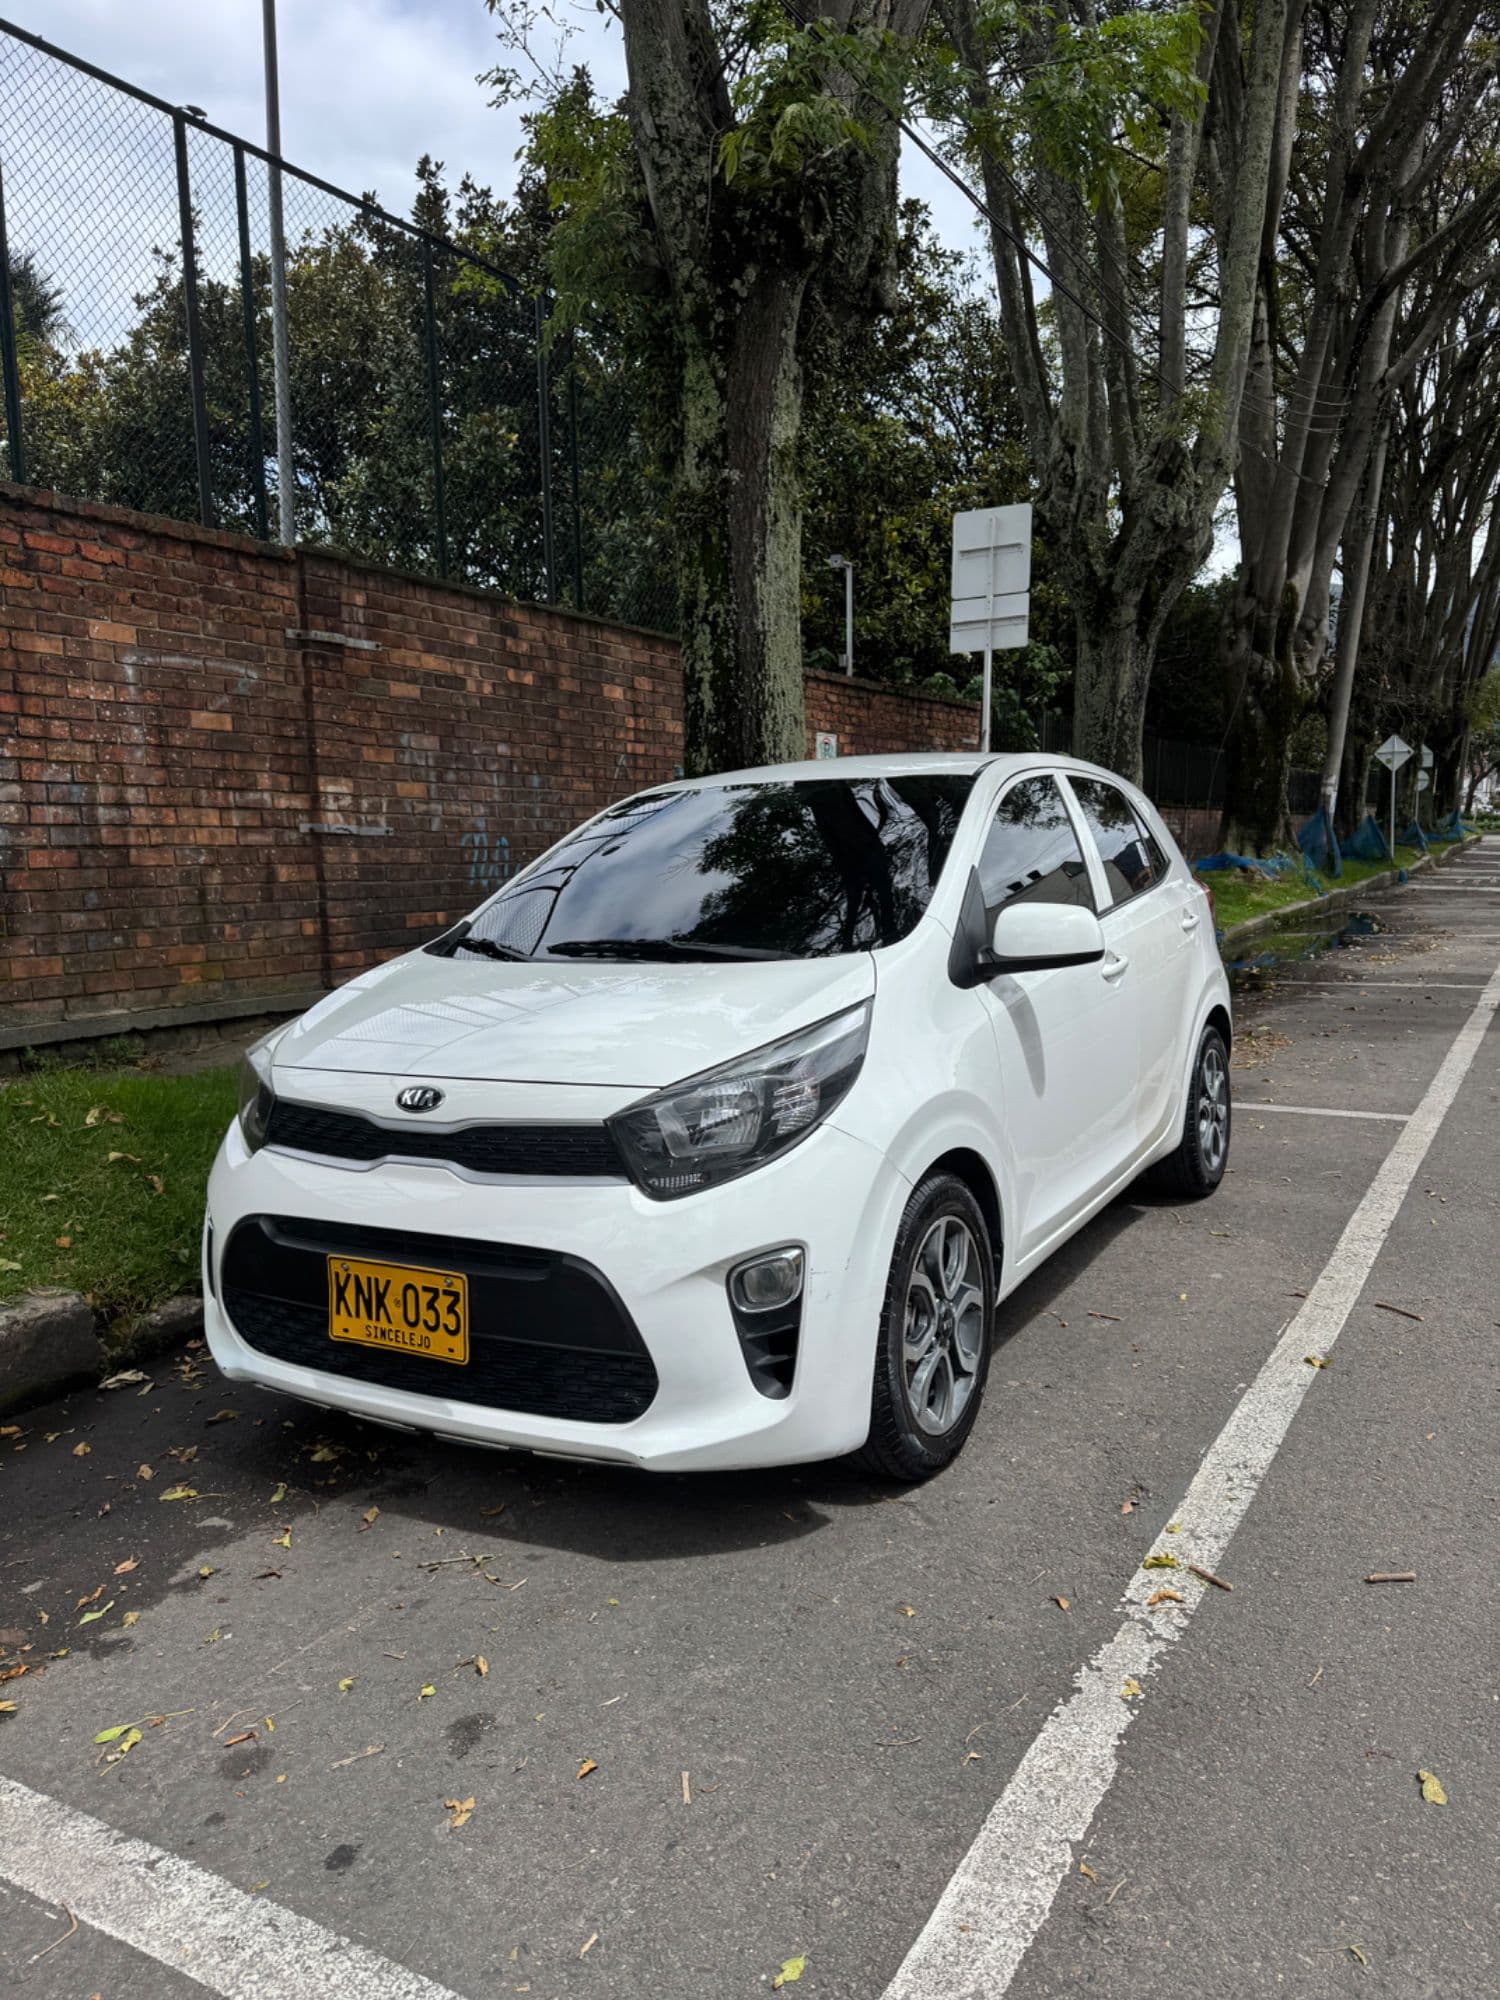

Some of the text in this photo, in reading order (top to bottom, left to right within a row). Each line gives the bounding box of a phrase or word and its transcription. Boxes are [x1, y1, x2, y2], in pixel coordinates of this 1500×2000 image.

[401, 1089, 434, 1106] KIA
[334, 1271, 461, 1337] KNK 033
[365, 1324, 431, 1350] SINCELEJO
